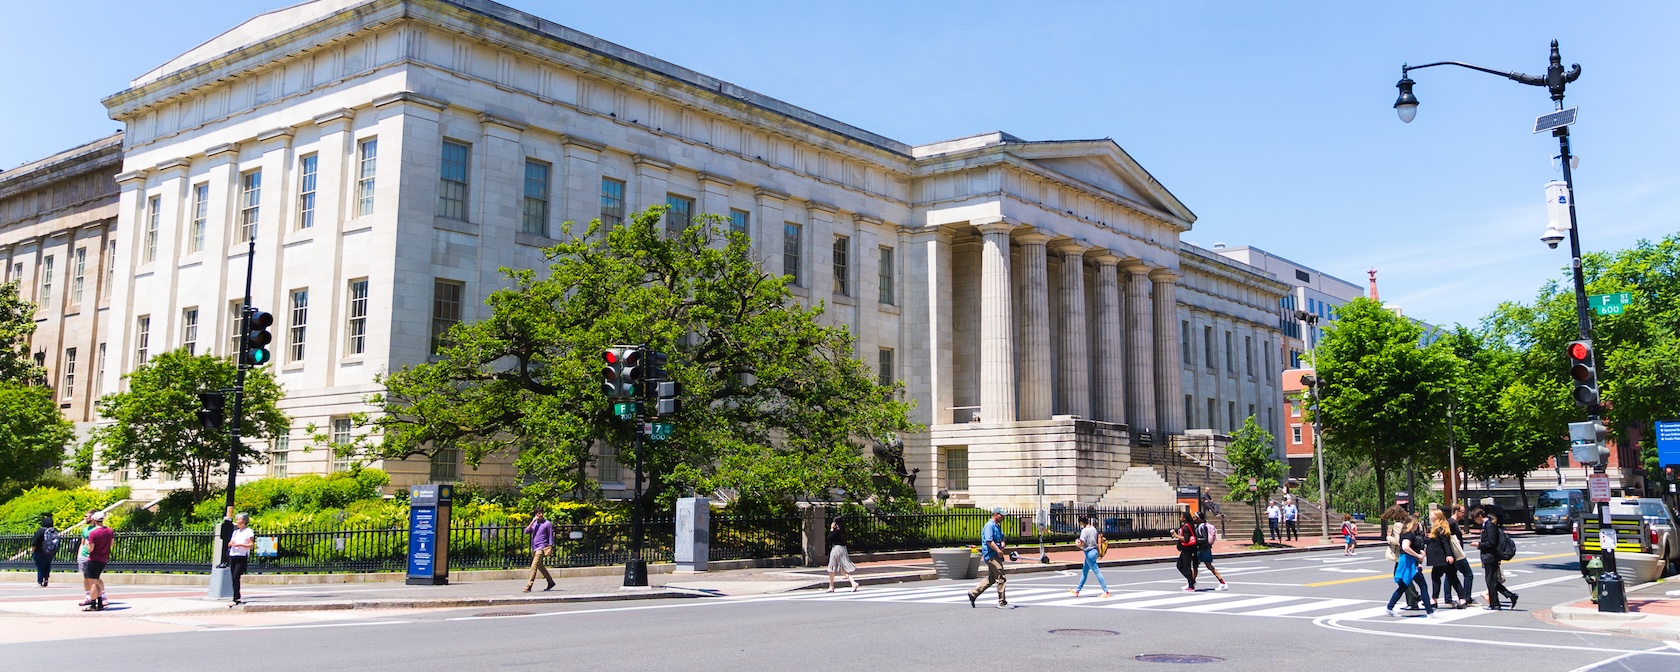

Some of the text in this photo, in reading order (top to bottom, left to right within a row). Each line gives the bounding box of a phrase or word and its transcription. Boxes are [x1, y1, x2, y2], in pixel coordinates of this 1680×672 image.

[1602, 295, 1610, 306] F
[620, 404, 626, 413] F
[655, 424, 662, 433] 7
